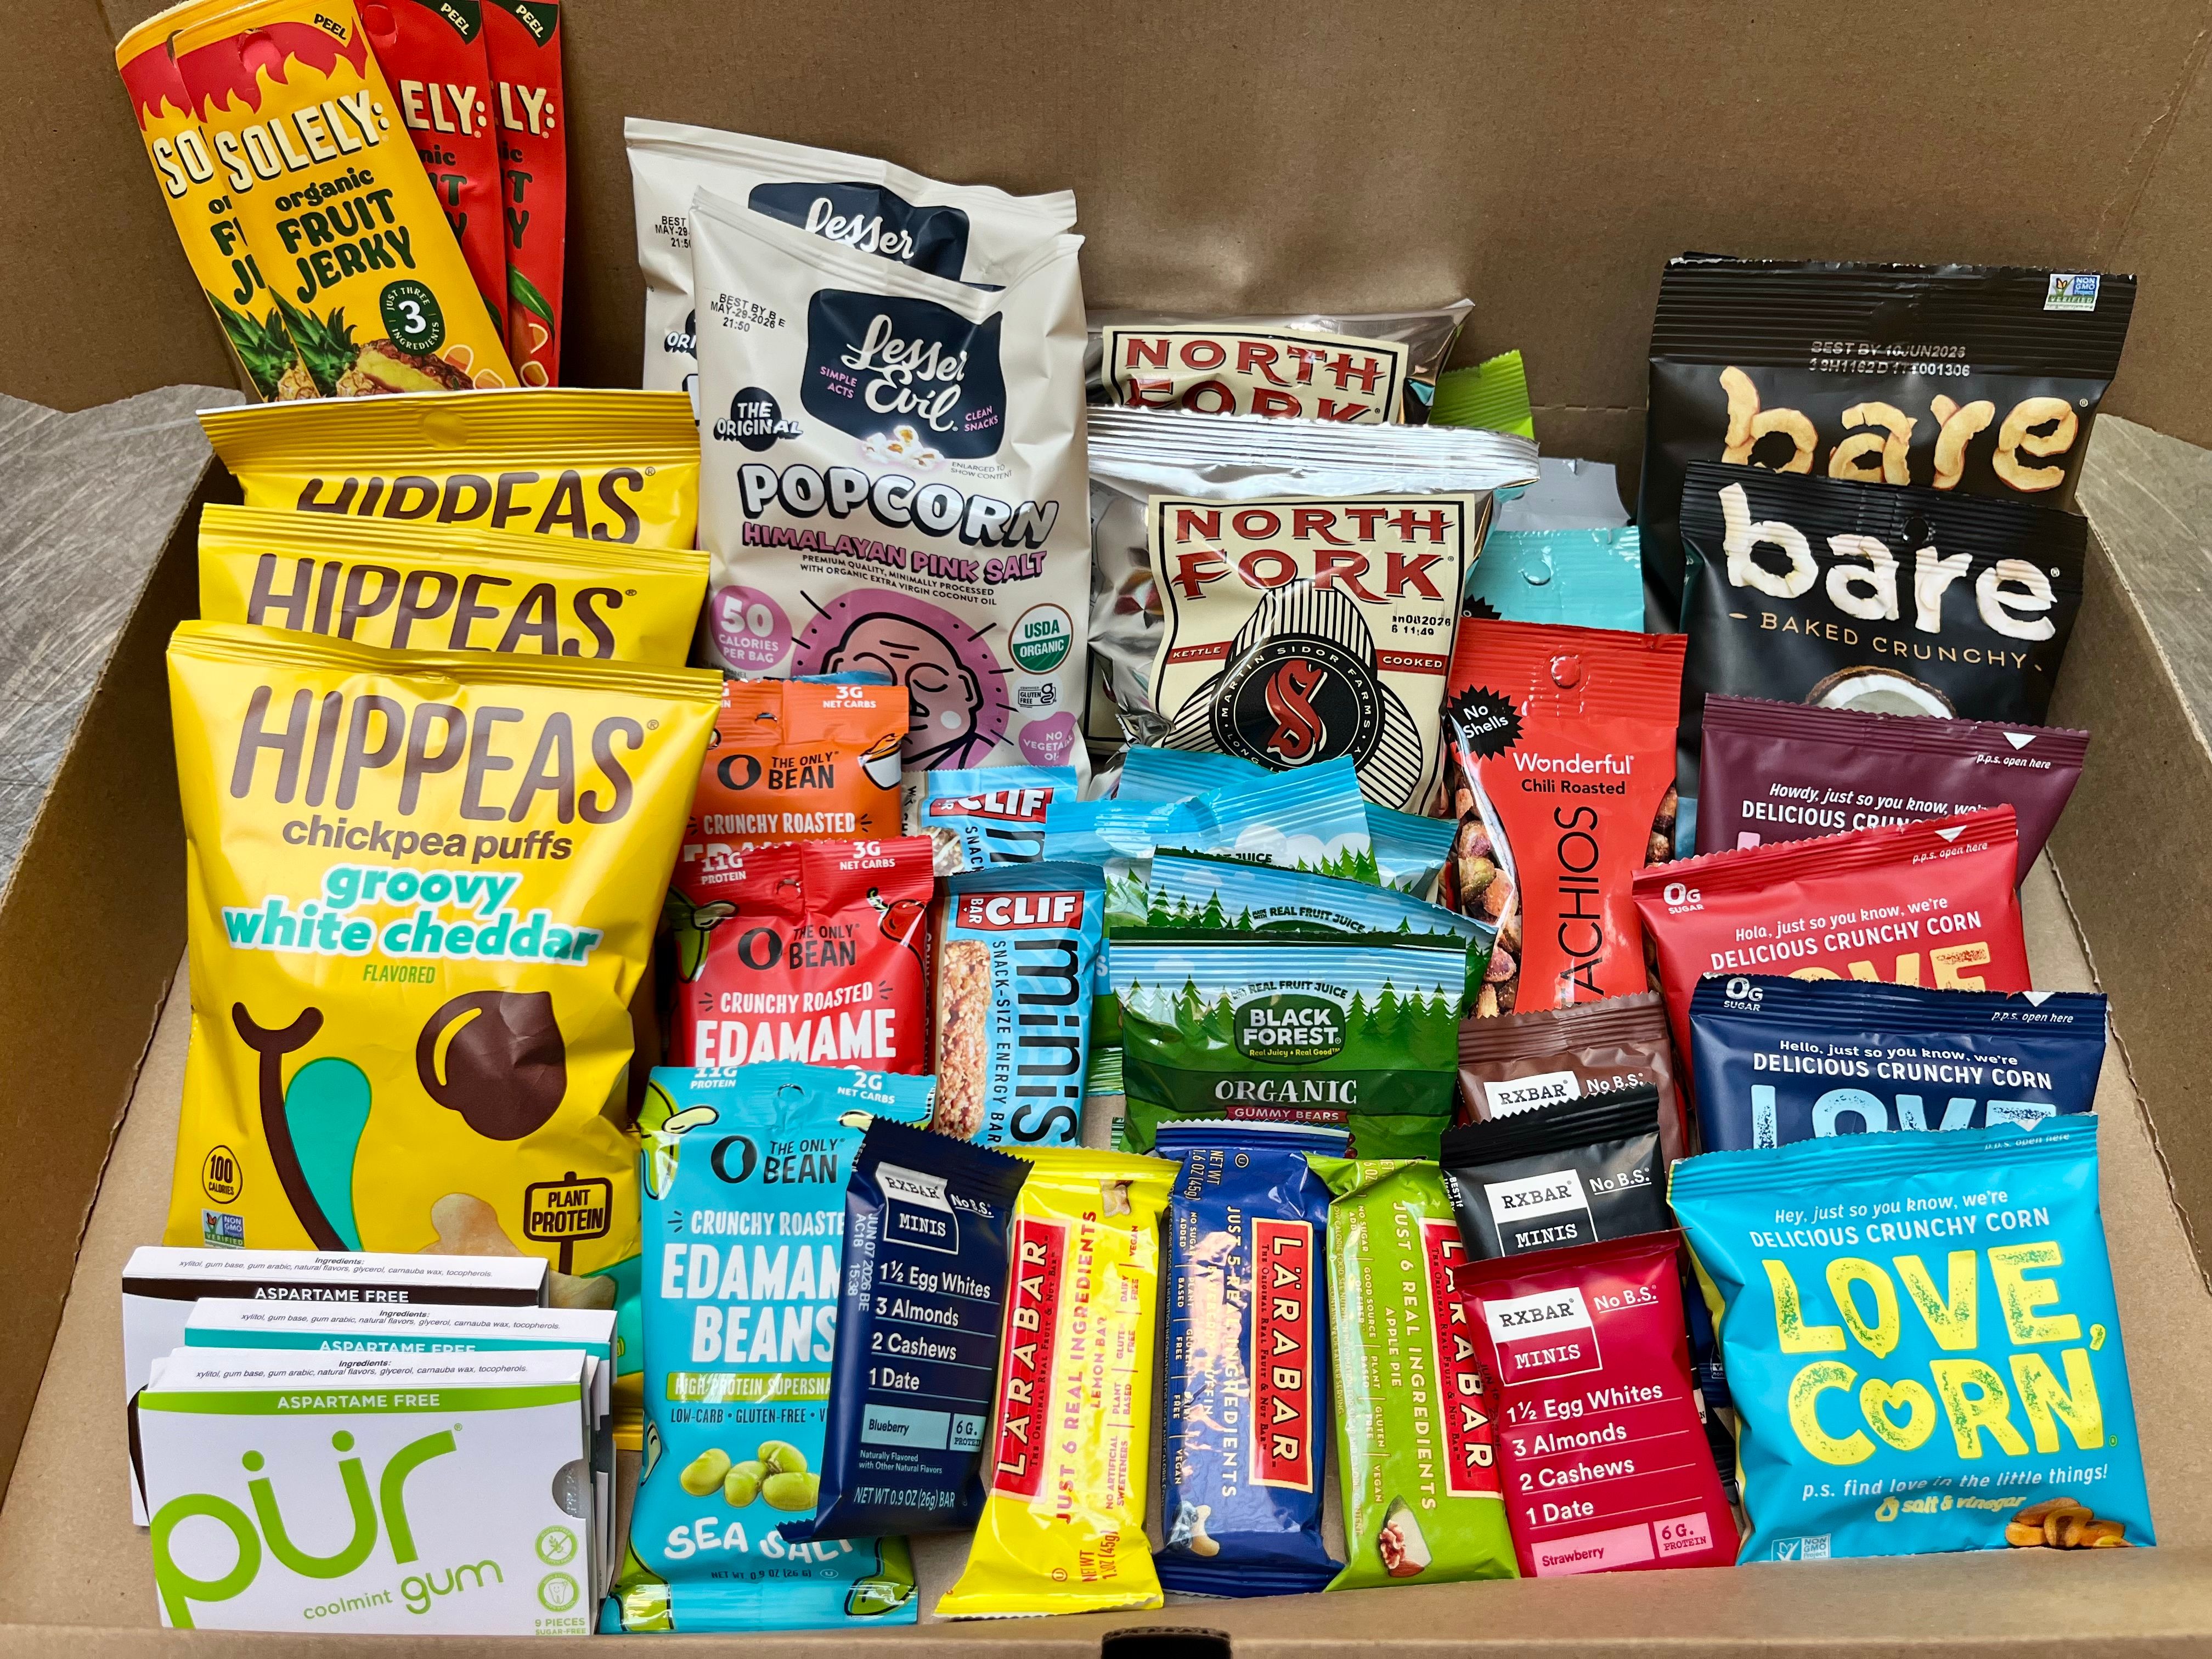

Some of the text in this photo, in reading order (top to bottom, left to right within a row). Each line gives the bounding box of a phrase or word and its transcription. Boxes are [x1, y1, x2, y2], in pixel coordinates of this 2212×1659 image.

[314, 13, 347, 41] PEEL
[275, 167, 374, 214] organic
[276, 189, 393, 255] FRUIT
[296, 227, 416, 303] JERKY
[386, 286, 431, 311] JUST THREE
[398, 300, 426, 334] 3
[723, 317, 751, 332] 21:50
[391, 321, 439, 350] INGREDIENTS
[841, 314, 969, 382] Lesser
[820, 366, 857, 388] SIMPLE
[827, 382, 854, 399] ACTS
[737, 402, 772, 419] THE
[964, 406, 994, 421] CLEAN
[716, 417, 803, 436] ORIGINAL
[964, 415, 998, 432] SNACKS
[738, 464, 1059, 548] POPCORN
[1176, 508, 1455, 545] NORTH
[742, 522, 1047, 584] HIMALAYAN PINK SALT
[1718, 482, 2057, 640] bare
[800, 565, 997, 605] WITH ORGANIC EXTRA VIRGIN COCONUT OIL
[803, 555, 994, 596] PREMIUM QUALITY, MINIMALLY PROCESSED
[1172, 548, 1444, 603] FORK
[721, 596, 774, 636] 50
[1024, 619, 1060, 639] USDA
[1761, 613, 2027, 668] BAKED CRUNCHY
[719, 634, 778, 652] CALORIES
[724, 647, 774, 663] PER BAG
[1020, 640, 1065, 657] ORGANIC
[1173, 647, 1221, 658] KETTLE
[1383, 656, 1443, 668] COOKED
[1222, 646, 1370, 729] MARTIN SIDOR FARMS
[1463, 704, 1489, 720] No
[1463, 713, 1509, 739] Shells
[230, 685, 645, 825] HIPPEAS
[1514, 753, 1631, 775] Wonderful
[1521, 778, 1626, 795] Chili Roasted
[282, 814, 573, 864] chickpea puffs
[853, 841, 882, 858] 3G
[701, 853, 744, 872] 11G
[840, 859, 895, 870] NET CARBS
[702, 871, 746, 884] PROTEIN
[327, 867, 518, 915] groovy
[969, 896, 1076, 926] BAR CLIF
[224, 900, 599, 961] white cheddar
[794, 924, 853, 939] THE ONLY
[789, 941, 856, 969] BEAN
[363, 964, 436, 984] FLAVORED
[721, 981, 873, 1014] CRUNCHY ROASTED
[1248, 981, 1348, 999] REAL FRUIT JUICE
[1250, 1009, 1331, 1026] BLACK
[695, 1009, 895, 1068] EDAMAME
[987, 941, 1011, 1143] SNACK-SIZE ENERGY BAR
[1011, 940, 1080, 1143] minis
[1244, 1027, 1339, 1045] FOREST
[1249, 1049, 1266, 1057] Real
[1267, 1049, 1289, 1058] Juicy
[1753, 1053, 2052, 1091] DELICIOUS CRUNCHY CORN
[1215, 1079, 1357, 1104] ORGANIC
[1234, 1107, 1339, 1120] GUMMY BEARS
[210, 1155, 233, 1182] 100
[208, 1182, 234, 1195] CALORIES
[548, 1189, 589, 1209] PLANT
[1775, 1190, 2008, 1224] Hey, just so you know, we're
[531, 1208, 603, 1232] PROTEIN
[1749, 1207, 2050, 1248] DELICIOUS CRUNCHY CORN
[1499, 1302, 1573, 1327] RXBAR
[1385, 1307, 1402, 1387] APPLE PIE
[1515, 1344, 1581, 1369] MINIS
[196, 1370, 221, 1379] xylitol,
[223, 1370, 241, 1379] gum
[244, 1370, 267, 1379] base,
[268, 1369, 287, 1378] gum
[289, 1369, 315, 1377] arabic,
[318, 1368, 345, 1376] natural
[348, 1367, 377, 1376] flavors,
[380, 1366, 414, 1376] glycerol,
[456, 1365, 476, 1374] wax,
[338, 1359, 391, 1368] Ingredients:
[278, 1395, 440, 1409] ASPARTAME FREE
[1787, 1348, 2104, 1466] CORN
[671, 1408, 806, 1423] LOW-CARB GLUTEN-FREE
[869, 1419, 909, 1435] Blueberry
[1513, 1423, 1627, 1457] 3 Almonds
[1520, 1458, 1634, 1491] 2 Cashews
[1803, 1483, 1835, 1501] p.s.
[1844, 1477, 1881, 1496] find
[1889, 1477, 1927, 1493] love
[1957, 1475, 1990, 1488] the
[1996, 1470, 2041, 1486] little
[2049, 1463, 2107, 1487] things!
[1526, 1500, 1594, 1524] 1 Date
[1663, 1536, 1707, 1551] PROTEIN
[1542, 1547, 1605, 1567] Strawberry
[303, 1560, 504, 1620] coolmint gum
[545, 1617, 585, 1627] PIECES
